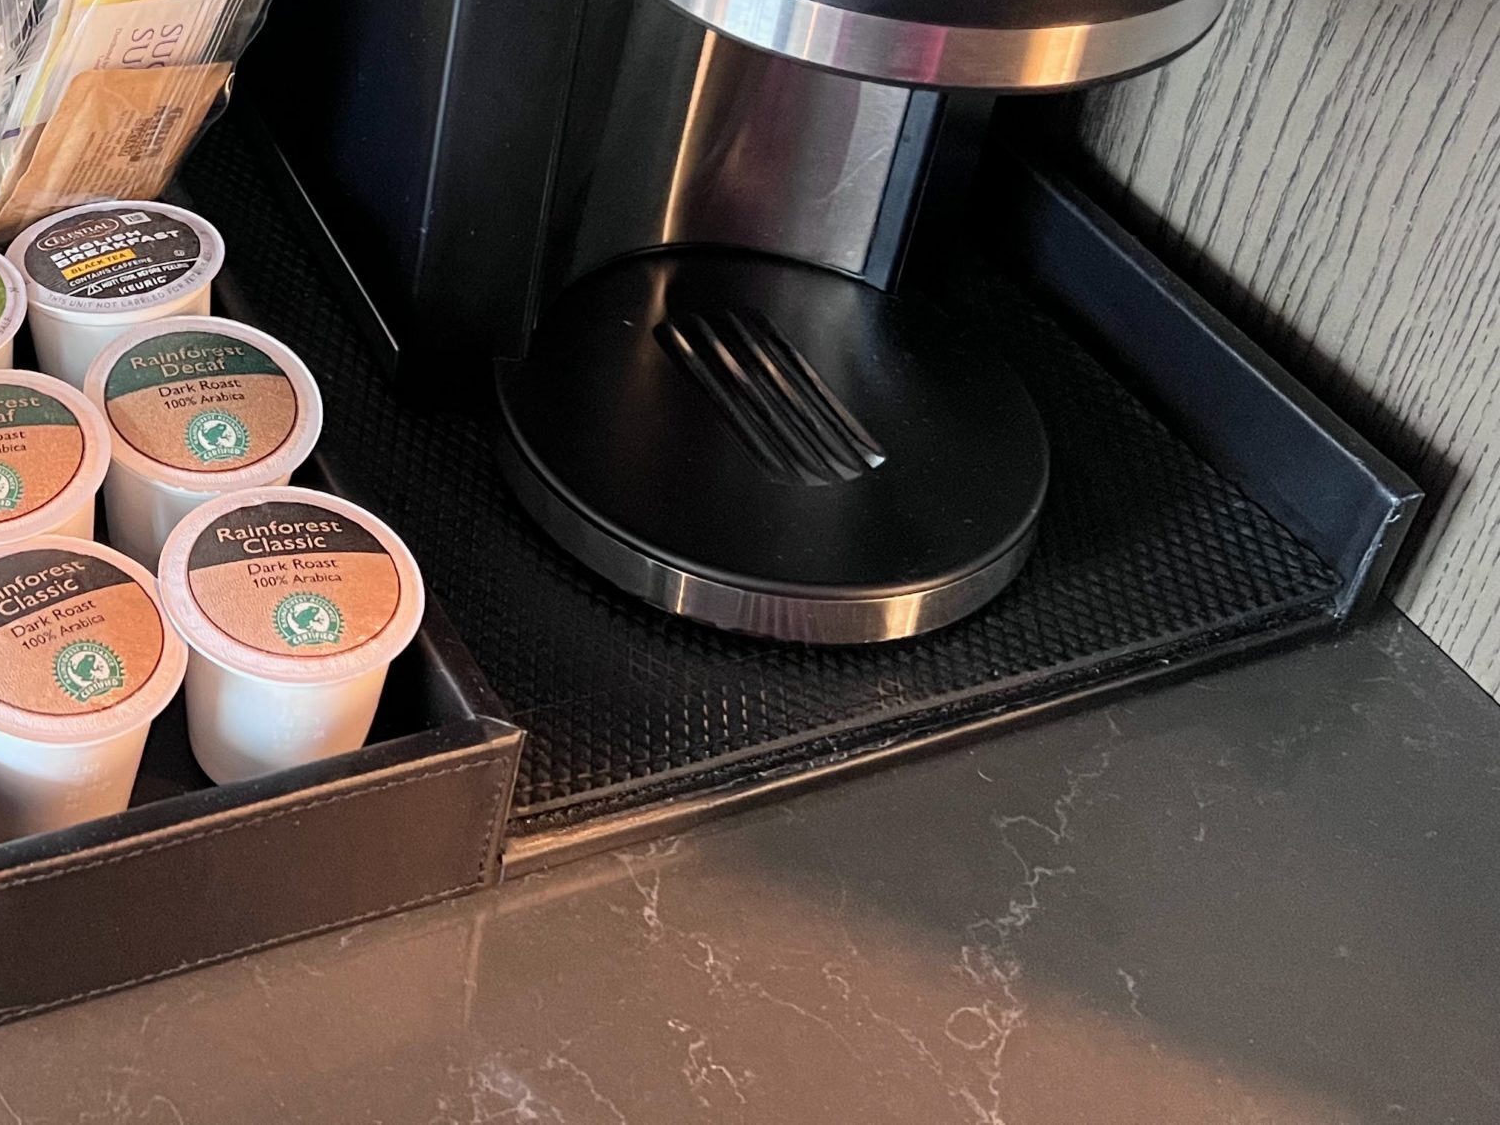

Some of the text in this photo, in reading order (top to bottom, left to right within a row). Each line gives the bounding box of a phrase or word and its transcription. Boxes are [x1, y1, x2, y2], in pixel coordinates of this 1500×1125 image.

[50, 229, 142, 263] ENGLISH
[55, 230, 180, 268] BREAKFAST
[71, 253, 126, 274] BLACK TEA
[119, 276, 167, 295] KEURIG
[0, 316, 13, 334] SALE
[130, 345, 245, 370] Rainforest
[161, 357, 227, 378] Decaf
[158, 379, 243, 399] Dark Roast
[163, 392, 246, 410] 100% Arabica
[216, 520, 343, 543] Rainforest
[243, 533, 328, 555] Classic
[247, 557, 339, 576] Dark Roast
[252, 572, 343, 589] 100% Arabica
[10, 600, 97, 639] Dark Roast
[21, 613, 106, 651] 100% Arabica
